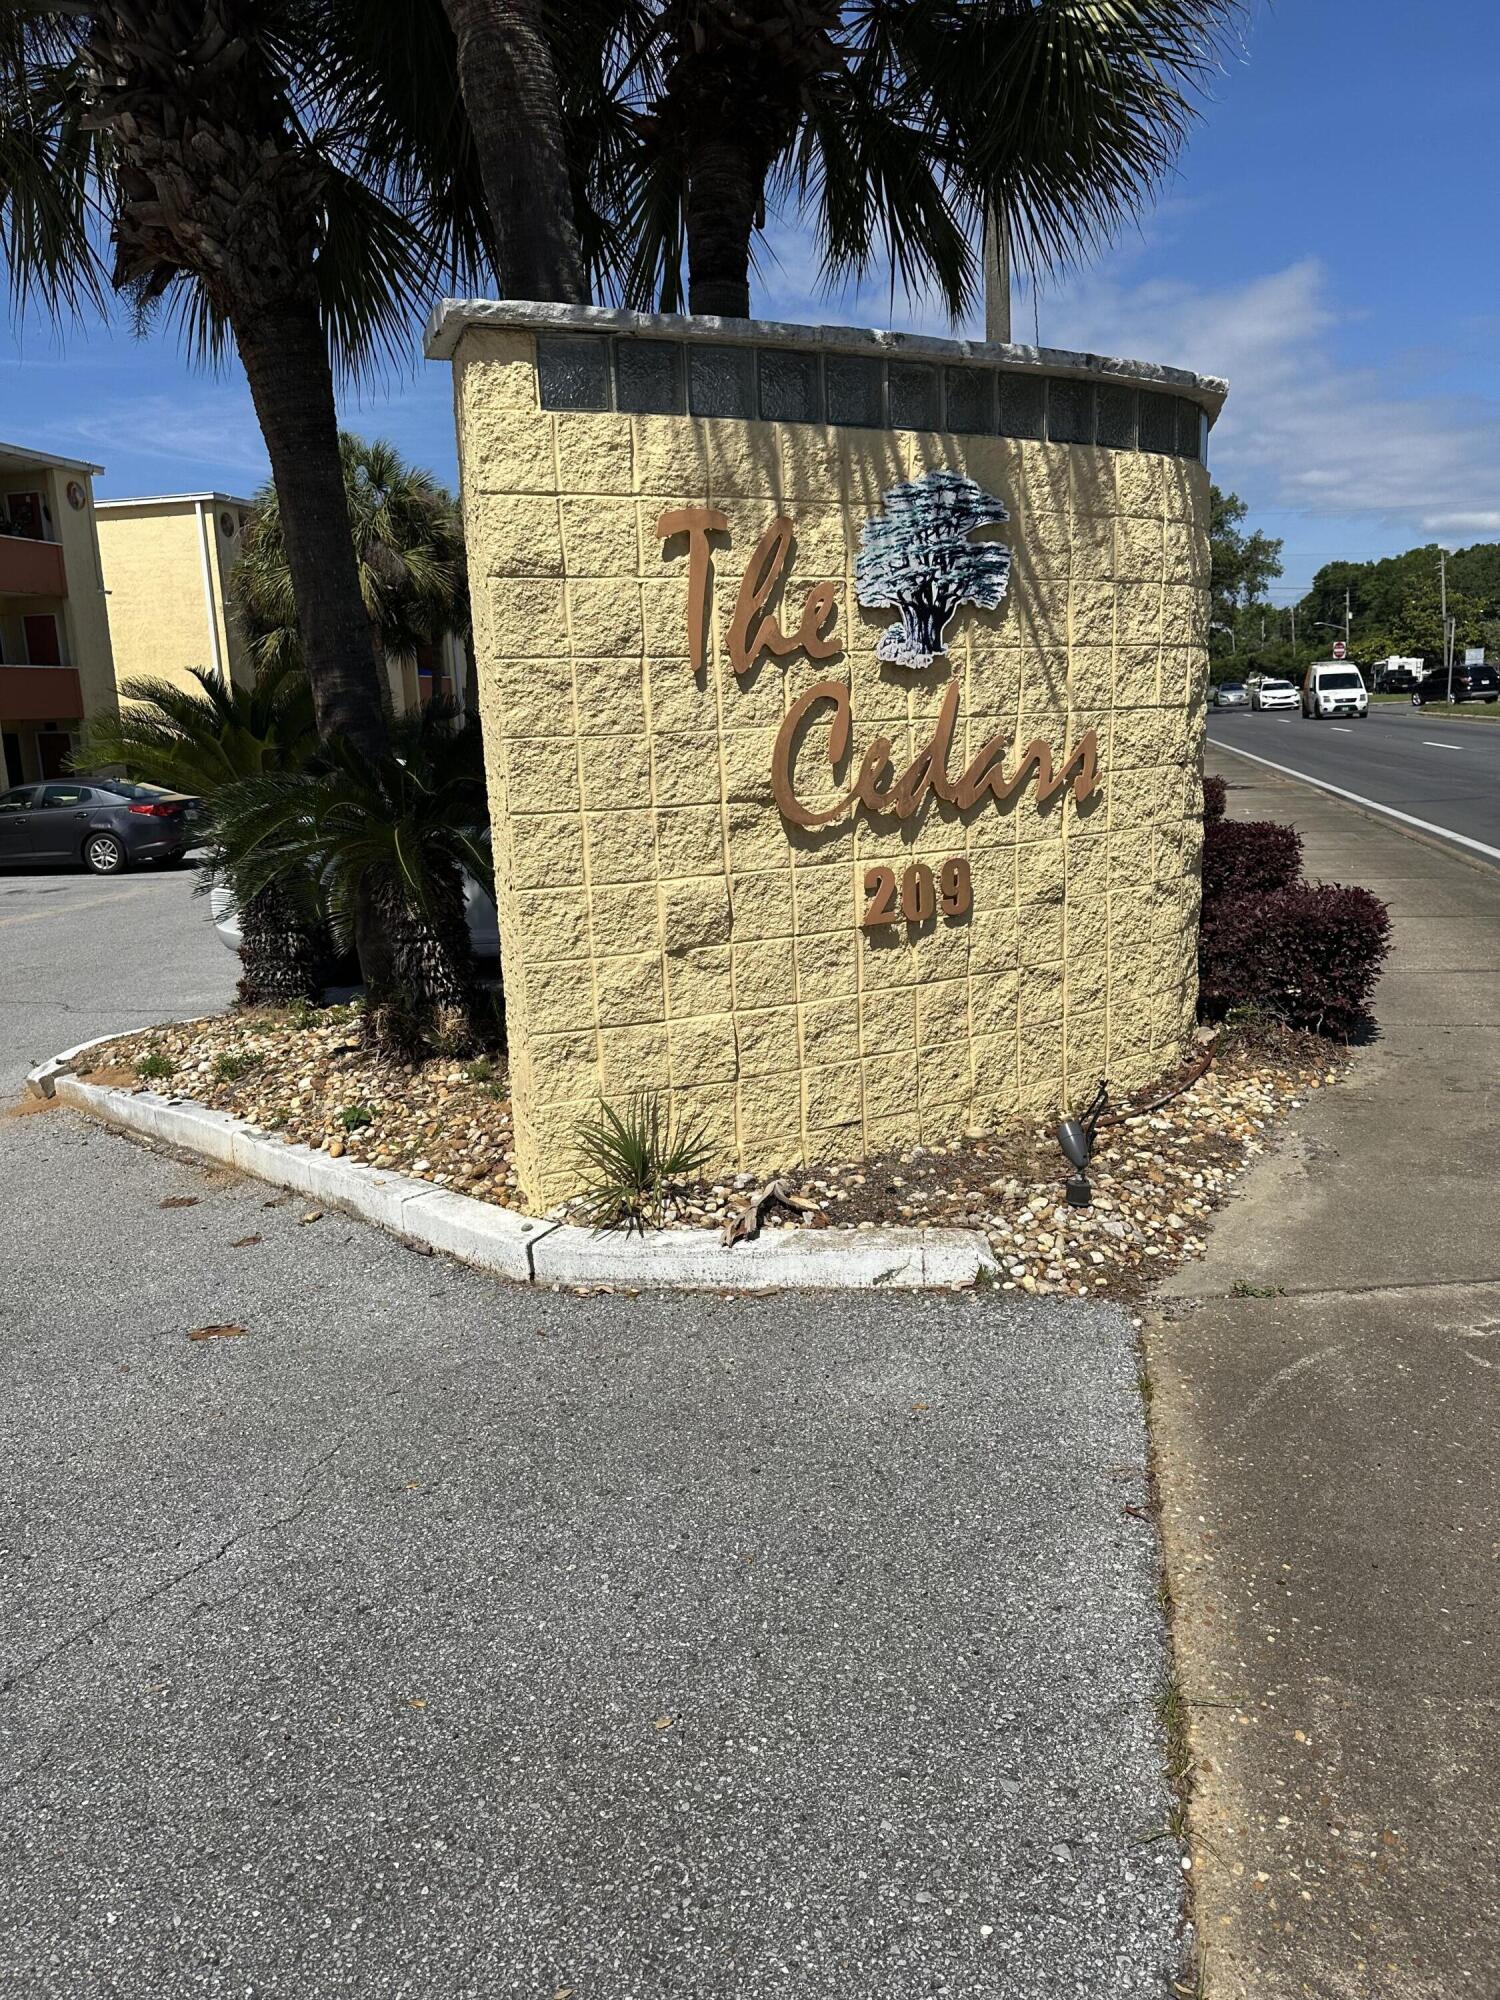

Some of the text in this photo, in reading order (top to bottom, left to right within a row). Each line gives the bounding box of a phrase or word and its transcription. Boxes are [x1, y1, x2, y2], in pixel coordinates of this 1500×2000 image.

[657, 509, 843, 674] The
[772, 680, 1102, 826] Cedars
[863, 857, 971, 926] 209
